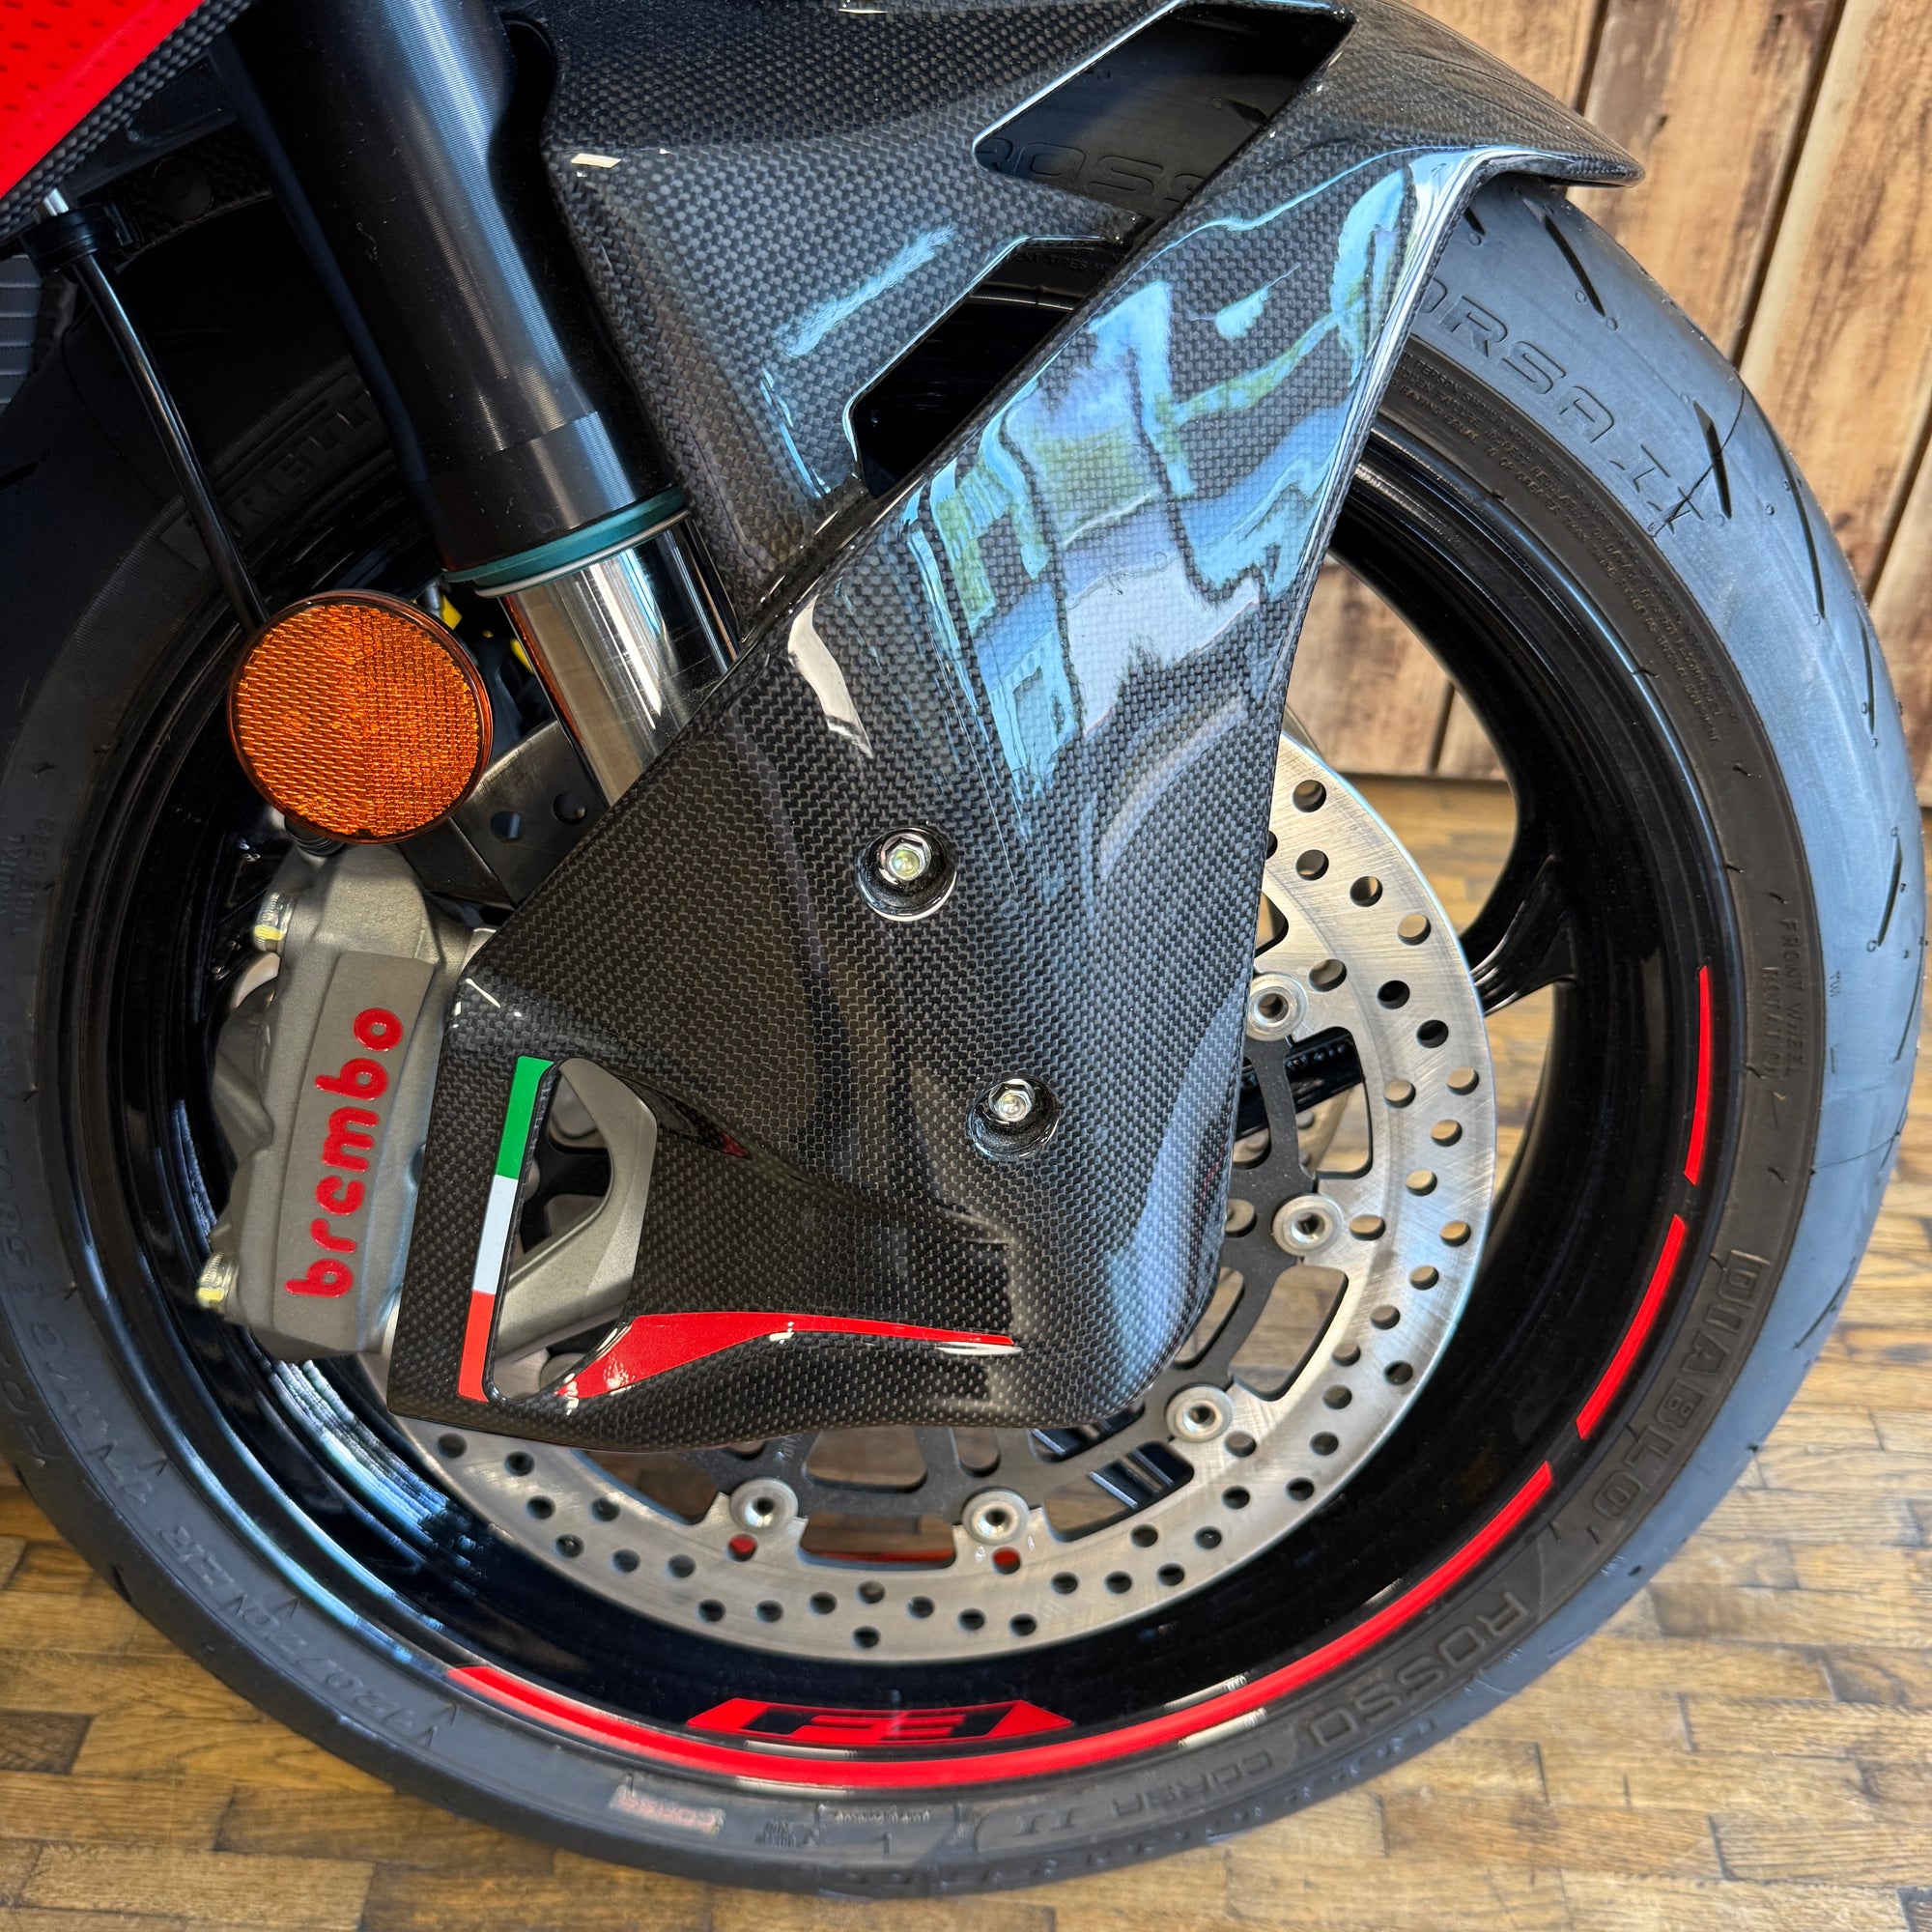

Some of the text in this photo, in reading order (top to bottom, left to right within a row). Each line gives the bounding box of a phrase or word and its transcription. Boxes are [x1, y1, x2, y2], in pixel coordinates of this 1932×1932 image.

[1394, 362, 1434, 393] UDDEN
[1400, 383, 1443, 417] RATING
[1413, 357, 1463, 396] PERSON
[1762, 966, 1785, 1080] ROTATION
[1779, 918, 1807, 1075] FRONT WHEEL
[1595, 1249, 1771, 1520] DIABLO
[1308, 1591, 1529, 1747] ROSSO
